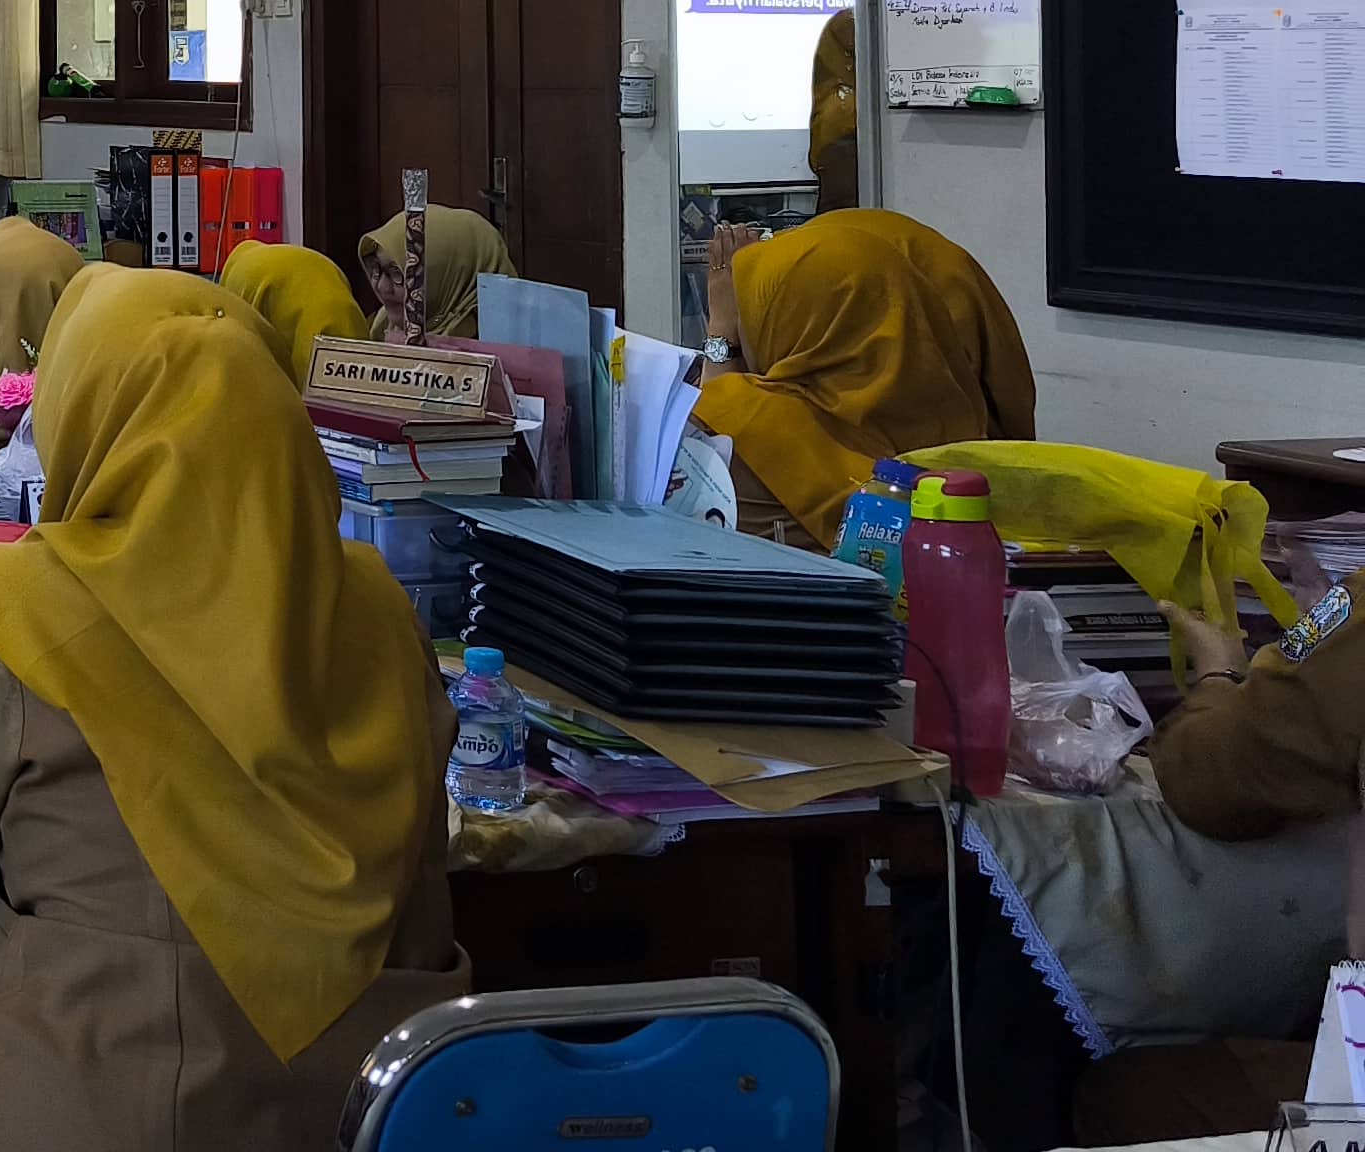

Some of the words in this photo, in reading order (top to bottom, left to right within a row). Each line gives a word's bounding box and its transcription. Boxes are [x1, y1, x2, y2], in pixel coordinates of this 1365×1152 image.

[324, 362, 365, 380] SARI
[370, 367, 456, 391] MUSTIKA
[461, 377, 473, 392] S
[858, 521, 902, 544] Relaxa
